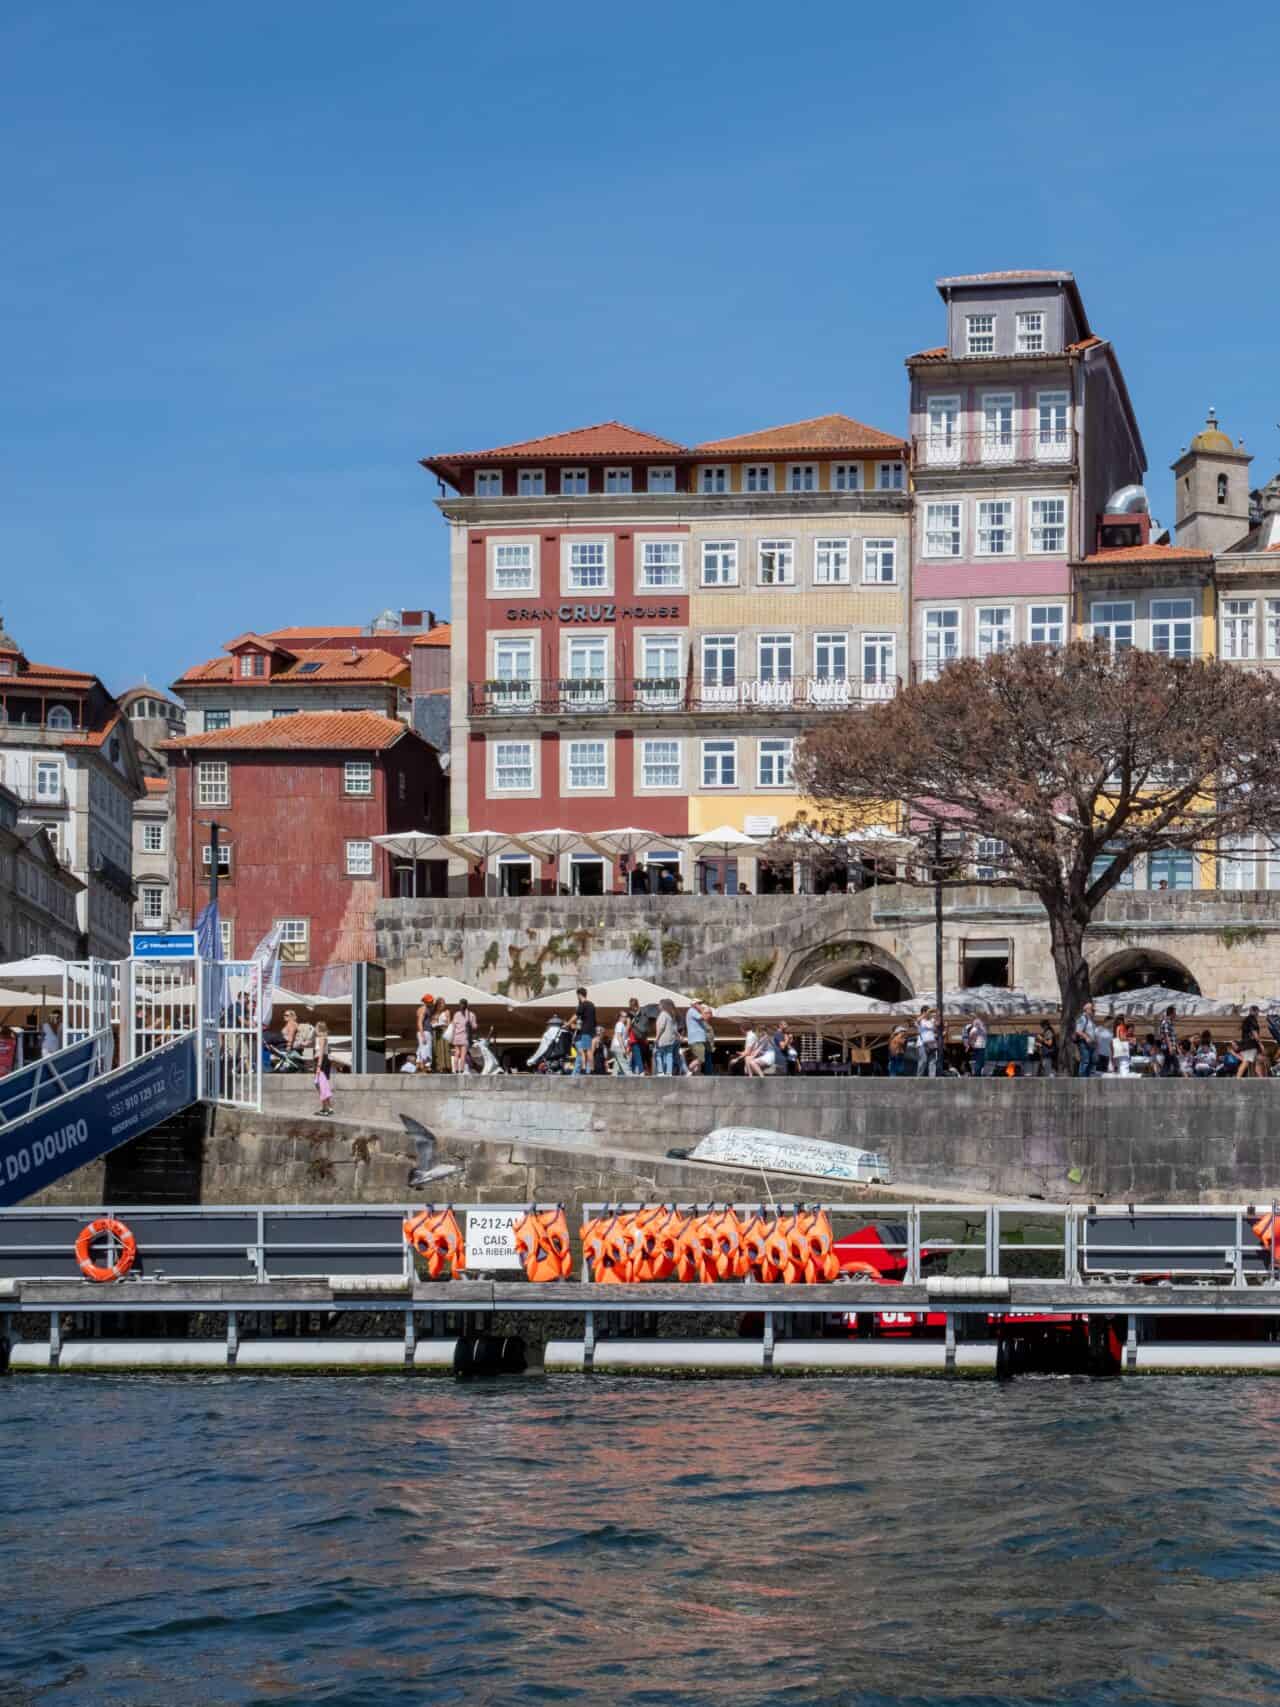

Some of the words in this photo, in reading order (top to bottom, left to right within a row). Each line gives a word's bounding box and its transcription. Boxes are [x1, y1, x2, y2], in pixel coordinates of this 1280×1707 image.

[506, 608, 554, 622] GRAN
[558, 604, 617, 623] CRUZ
[622, 606, 681, 620] HOUSE
[742, 680, 791, 705] PORTO
[807, 677, 852, 704] RIVER
[125, 1094, 140, 1111] 910
[6, 1148, 31, 1181] DO
[32, 1118, 89, 1167] DOURO
[470, 1217, 518, 1229] P-212-A
[483, 1235, 508, 1246] CAIS
